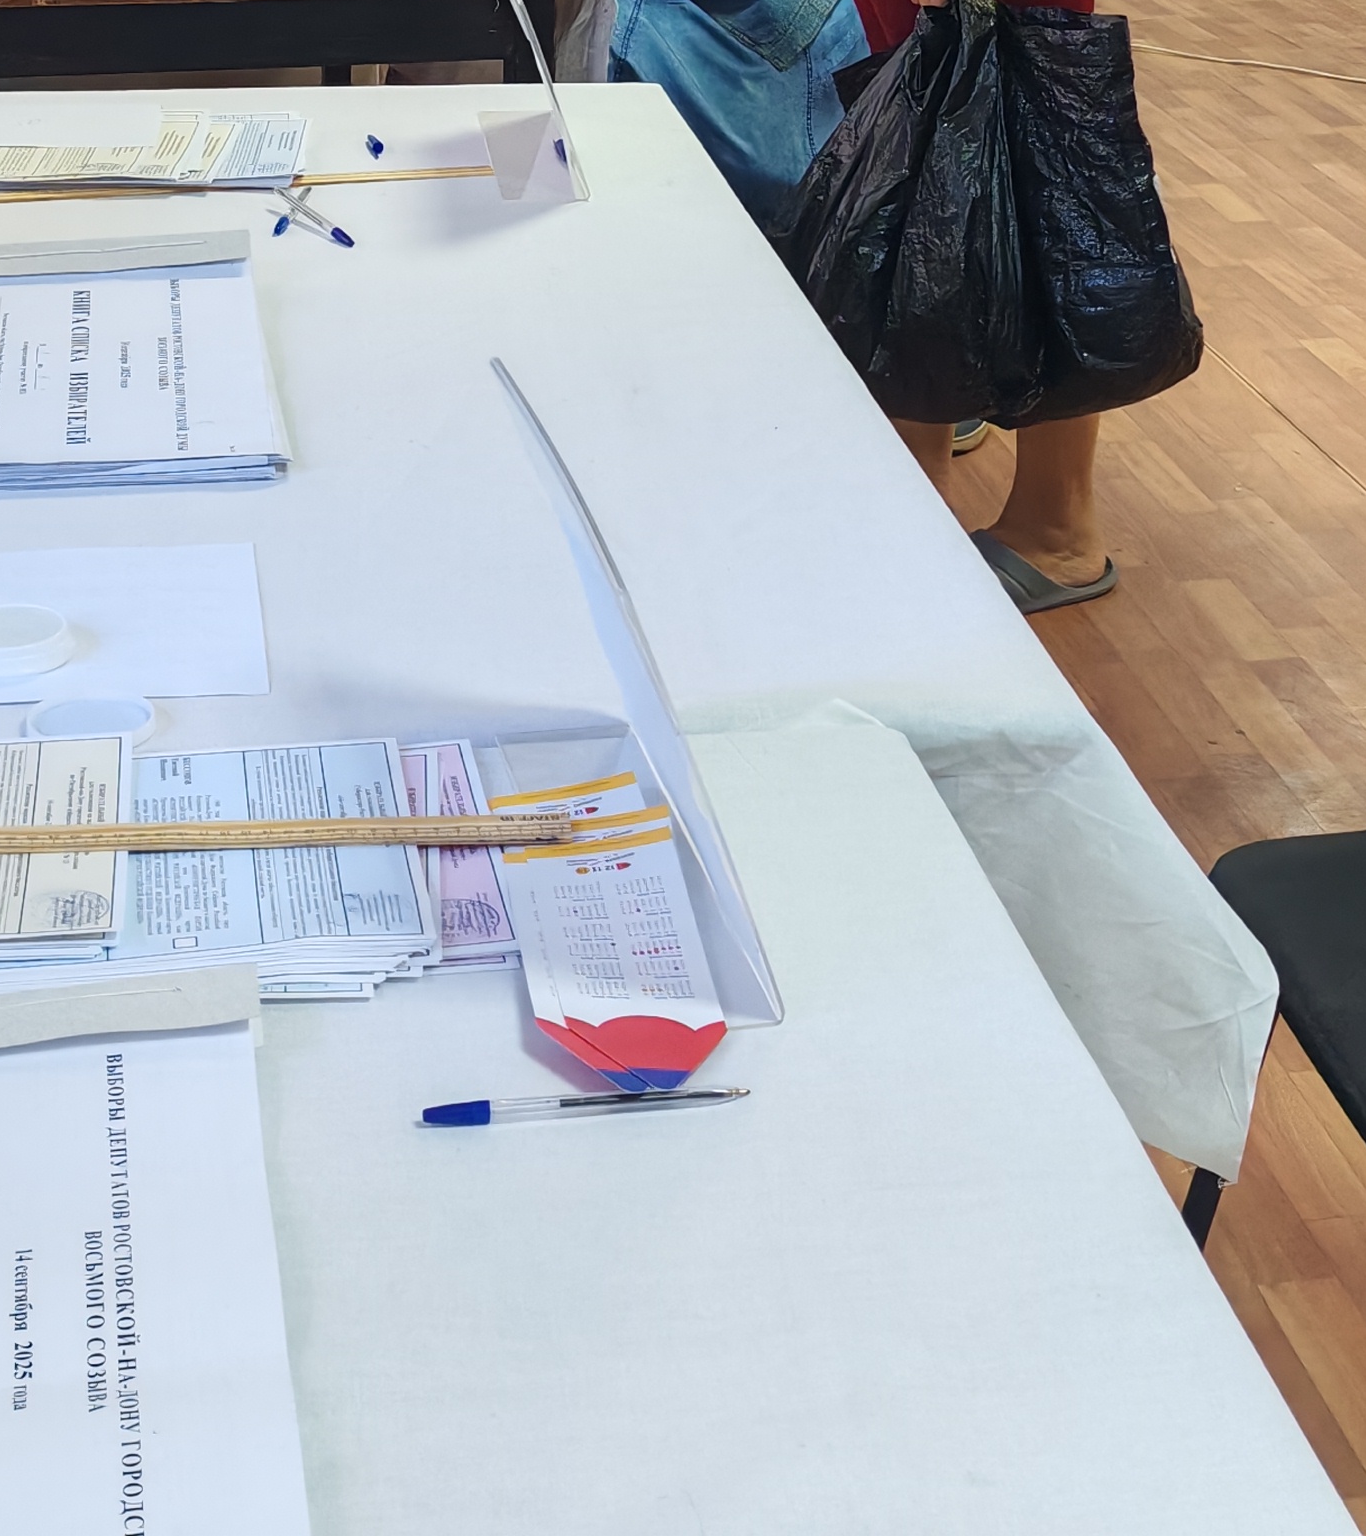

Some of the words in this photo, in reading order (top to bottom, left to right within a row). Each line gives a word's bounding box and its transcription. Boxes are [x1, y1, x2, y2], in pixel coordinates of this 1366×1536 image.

[71, 290, 91, 324] КНИГА
[70, 326, 90, 363] СПИСКА
[66, 372, 92, 445] ИЗБИРАТЕЛЕЙ
[106, 1053, 126, 1121] ВЫБОРЫ
[106, 1127, 131, 1219] ДЕПУТАТОВ
[14, 1249, 33, 1261] 14
[85, 1230, 106, 1329] ВОСЬМОГО
[9, 1265, 33, 1331] сентября
[112, 1224, 141, 1433] РОСТОВСКОЙ-НА-ДОНУ
[13, 1341, 33, 1380] 2025
[86, 1337, 108, 1413] СОЗЫВА
[12, 1385, 29, 1411] года
[118, 1440, 146, 1536] ГОРОДС
